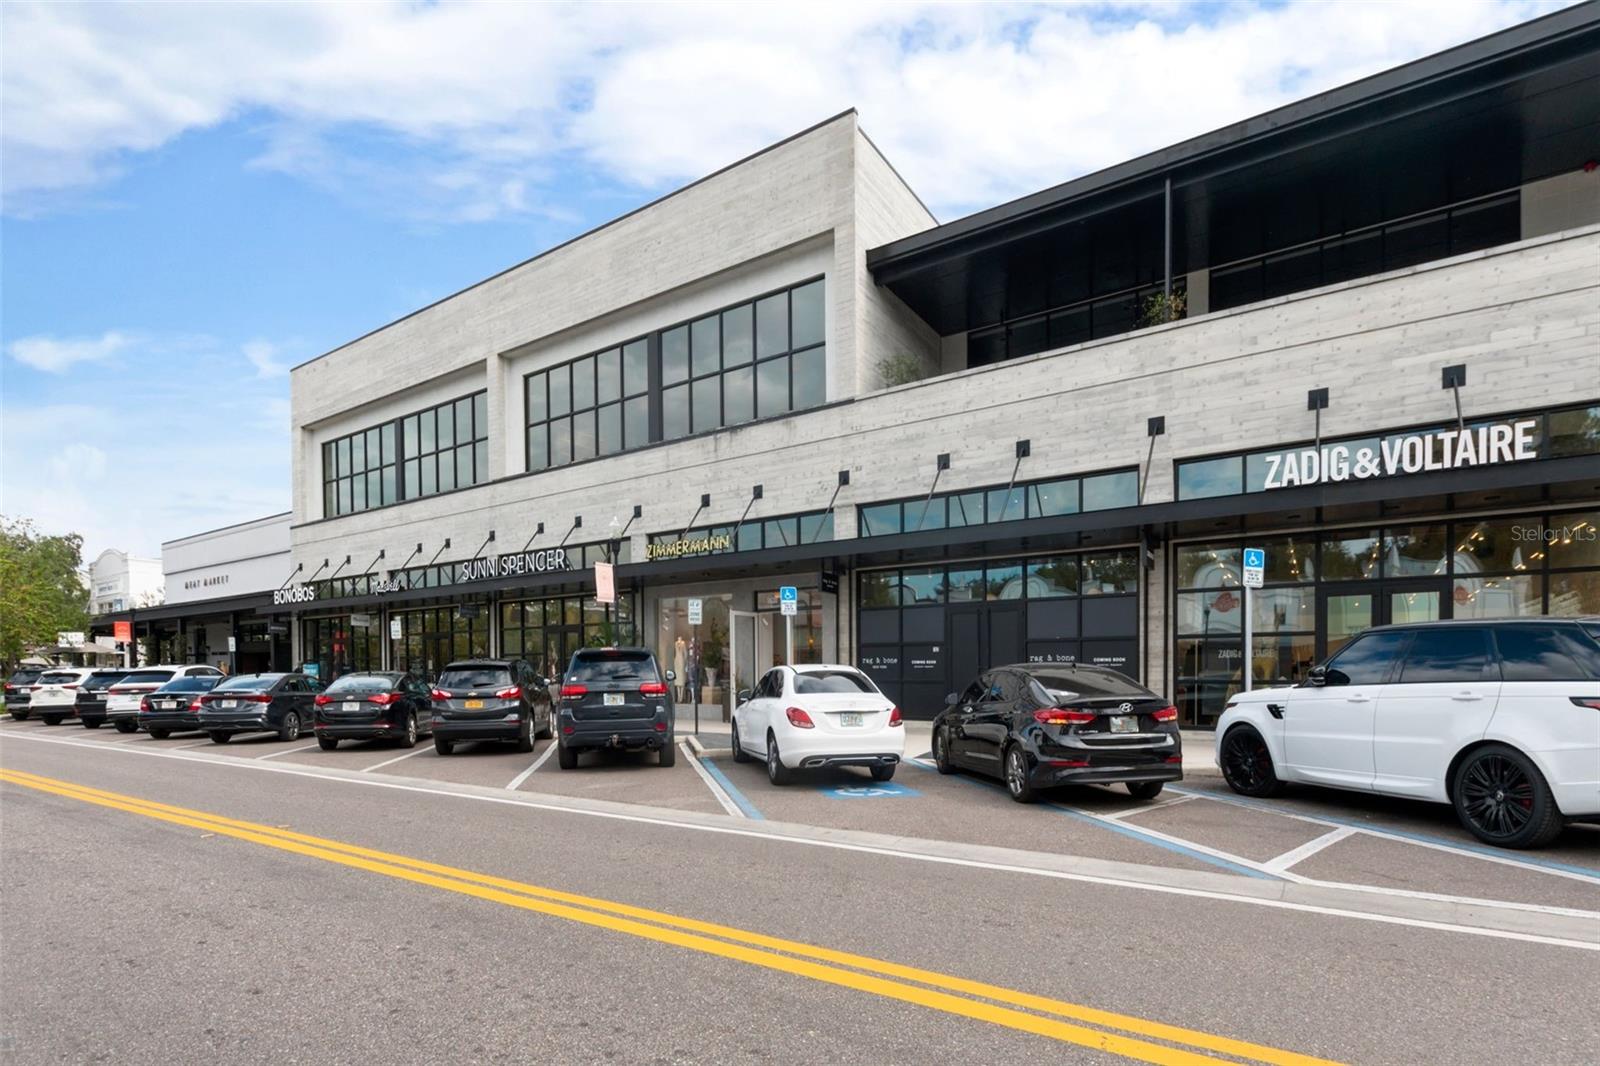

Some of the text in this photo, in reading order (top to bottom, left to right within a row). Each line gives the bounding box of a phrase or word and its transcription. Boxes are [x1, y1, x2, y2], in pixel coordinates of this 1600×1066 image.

[647, 535, 730, 559] ZIMMERMANN
[462, 549, 565, 580] SUNNI SPENCER
[273, 586, 315, 604] BONOBOS
[1056, 654, 1076, 662] bone
